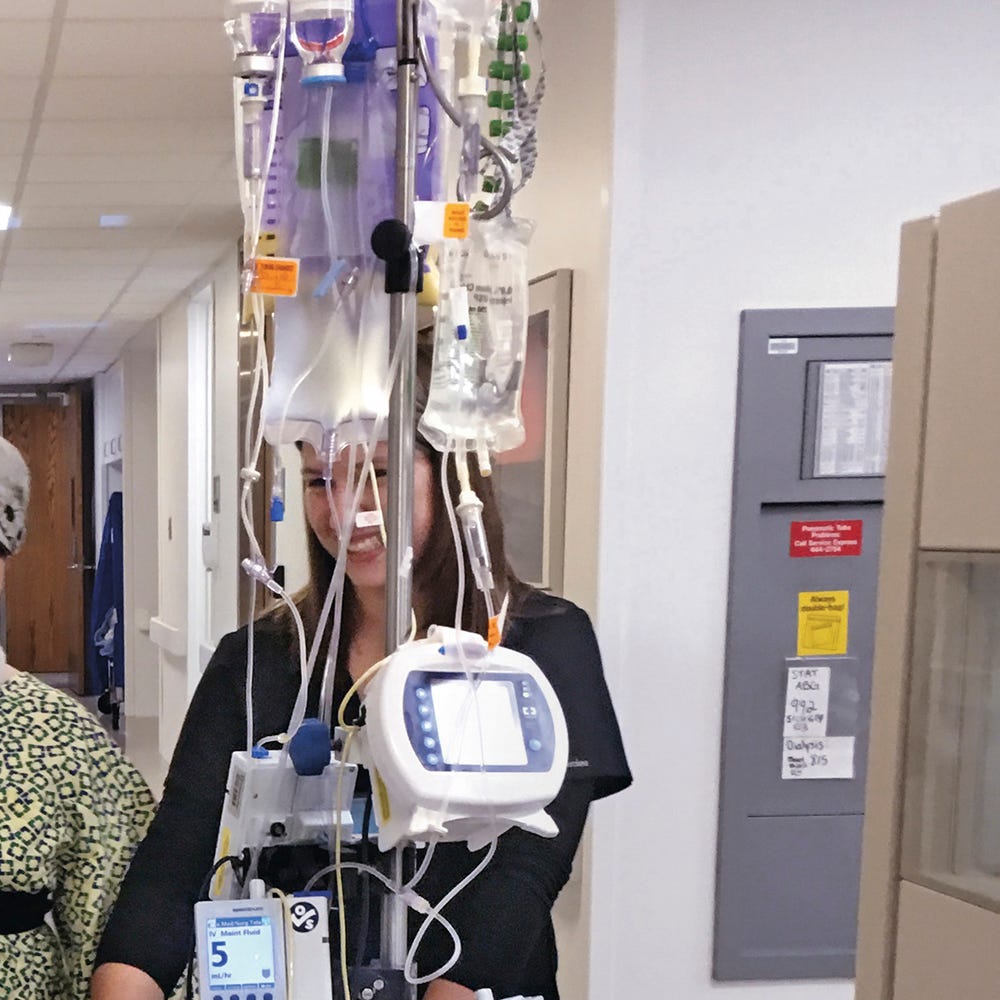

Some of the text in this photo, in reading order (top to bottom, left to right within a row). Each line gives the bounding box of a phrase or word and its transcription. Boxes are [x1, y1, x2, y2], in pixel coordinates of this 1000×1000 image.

[810, 596, 836, 604] Always
[792, 669, 817, 679] STAT
[790, 699, 817, 714] 992
[785, 740, 824, 753] Dialysis
[211, 941, 228, 967] 5
